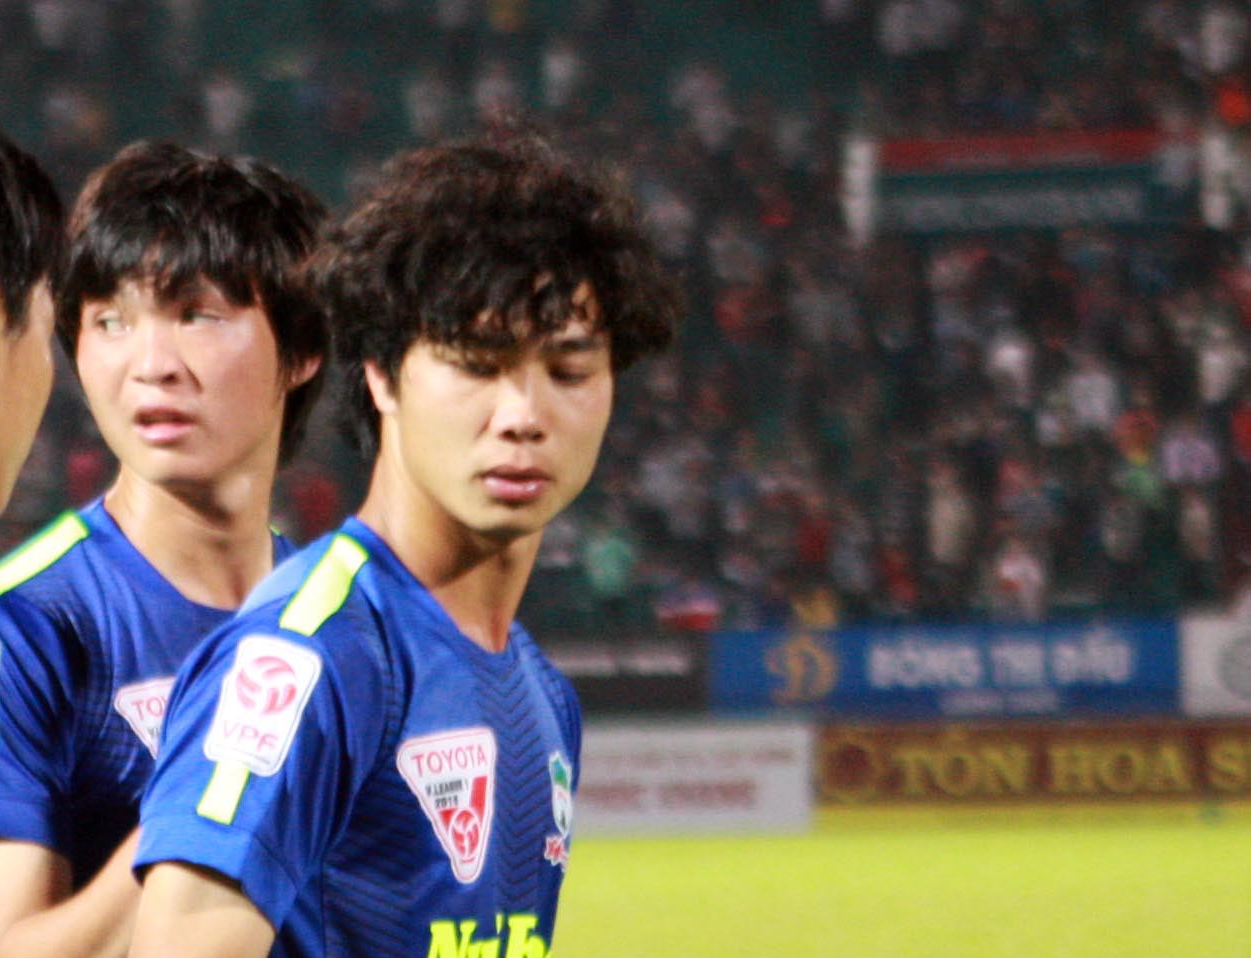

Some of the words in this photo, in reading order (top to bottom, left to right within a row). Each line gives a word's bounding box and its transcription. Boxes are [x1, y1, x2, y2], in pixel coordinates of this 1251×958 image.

[130, 695, 166, 721] TO
[222, 719, 280, 753] VPF
[411, 744, 487, 777] TOYOTA
